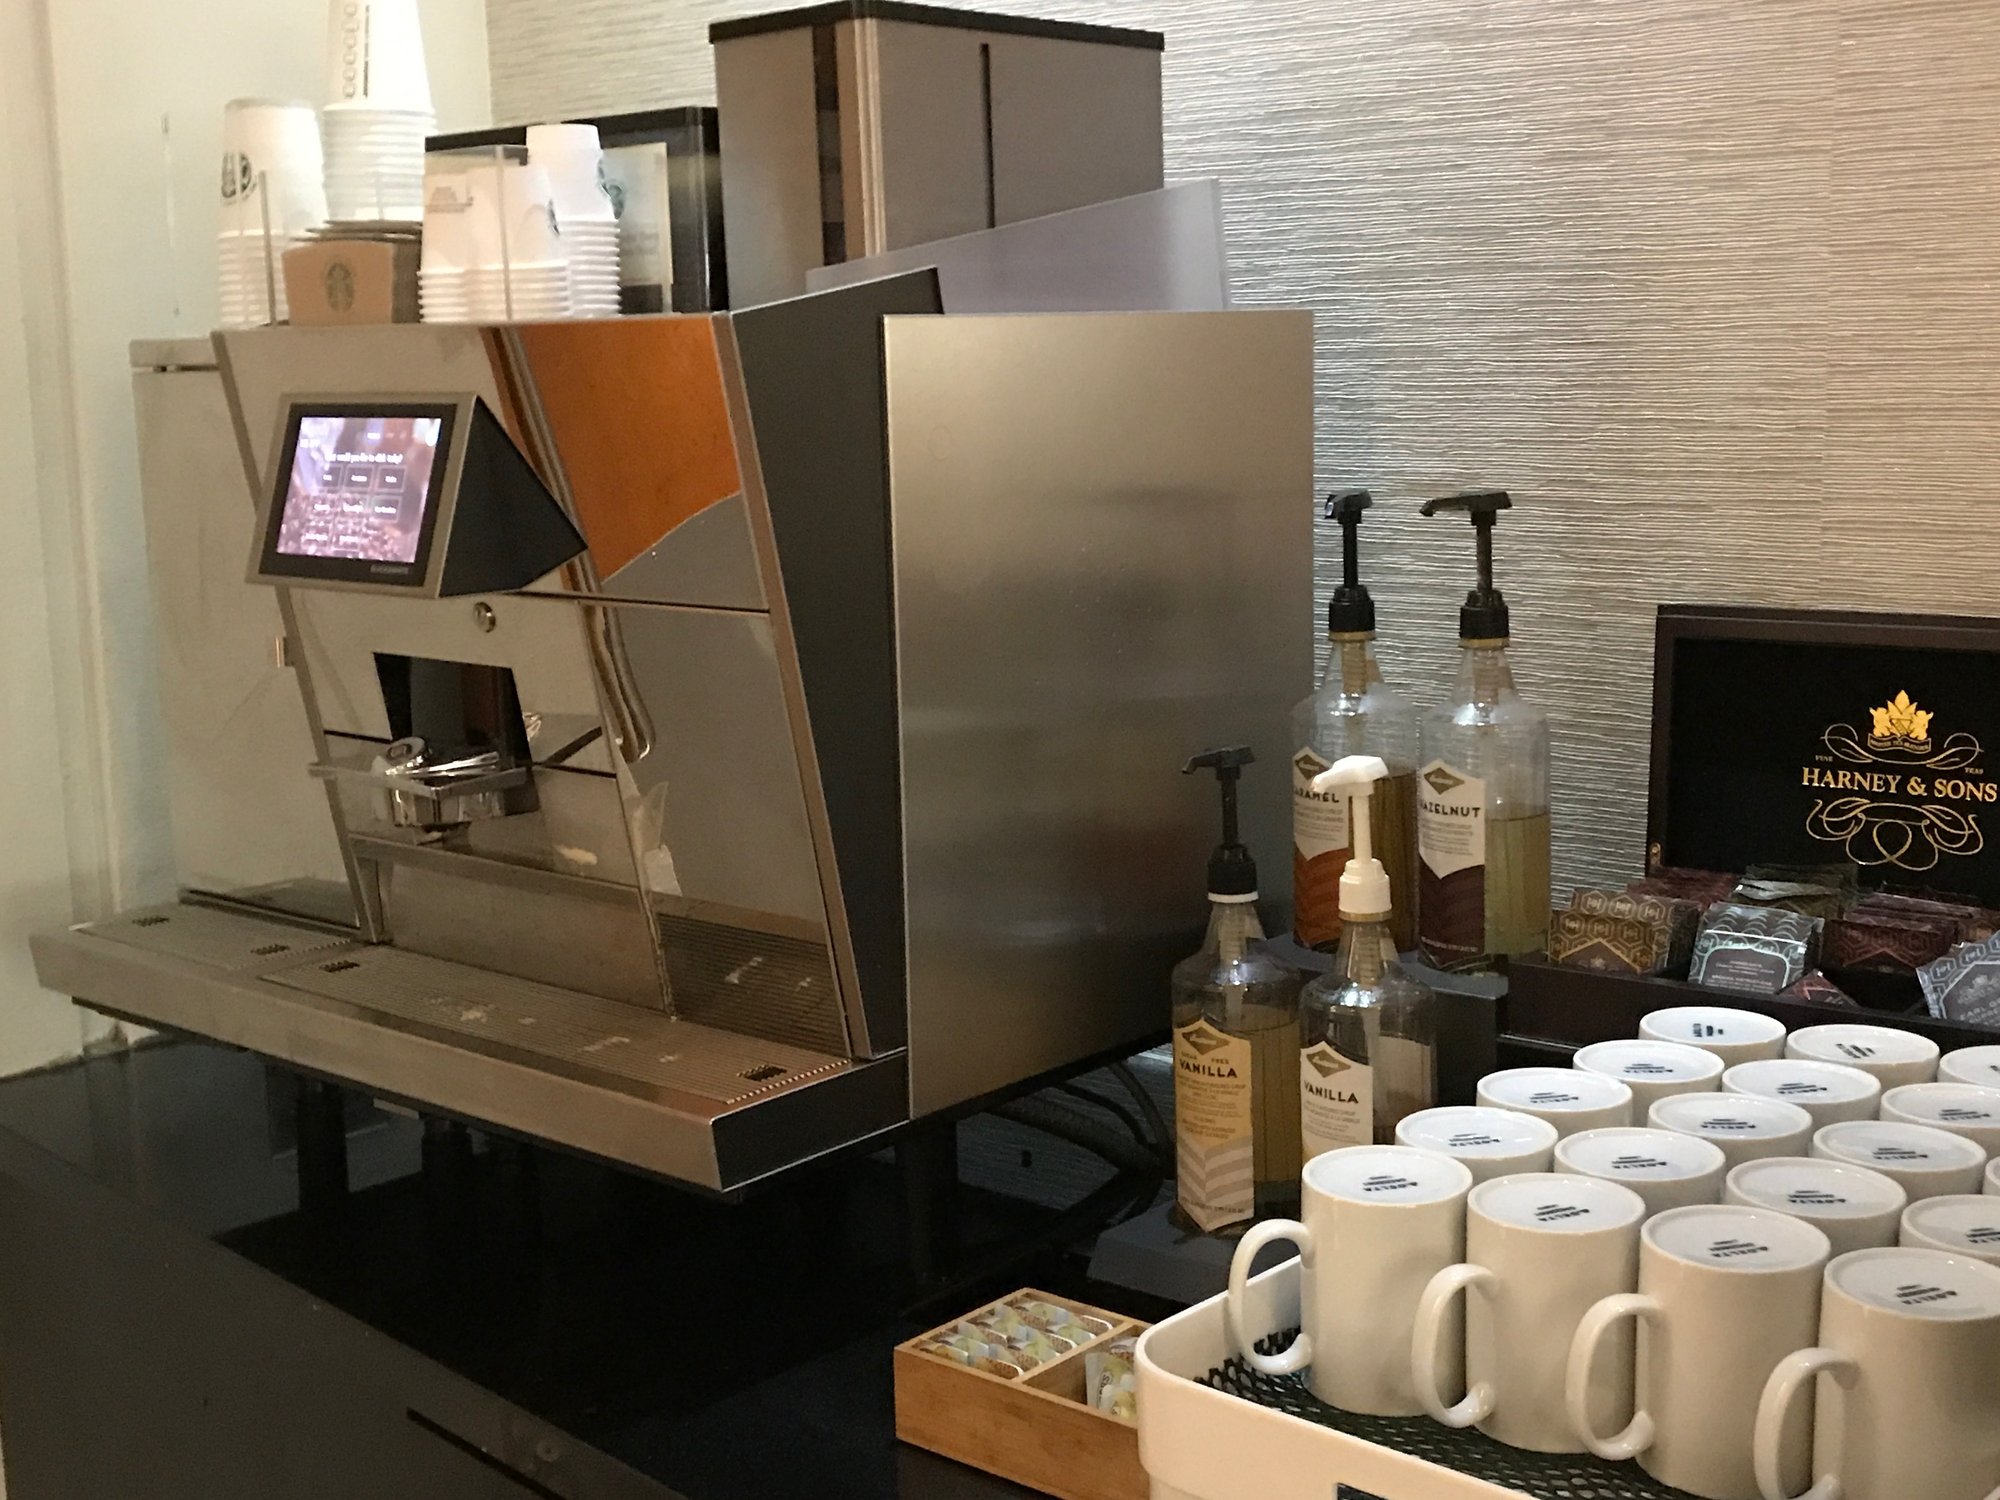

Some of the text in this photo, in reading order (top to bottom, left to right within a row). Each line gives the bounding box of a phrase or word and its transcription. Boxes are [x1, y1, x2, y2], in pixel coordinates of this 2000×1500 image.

[1802, 766, 1998, 802] HARNEY & SONS
[1294, 787, 1340, 804] ARAMEL
[1179, 1058, 1238, 1078] VANILLA
[1304, 1080, 1360, 1104] VANILLA
